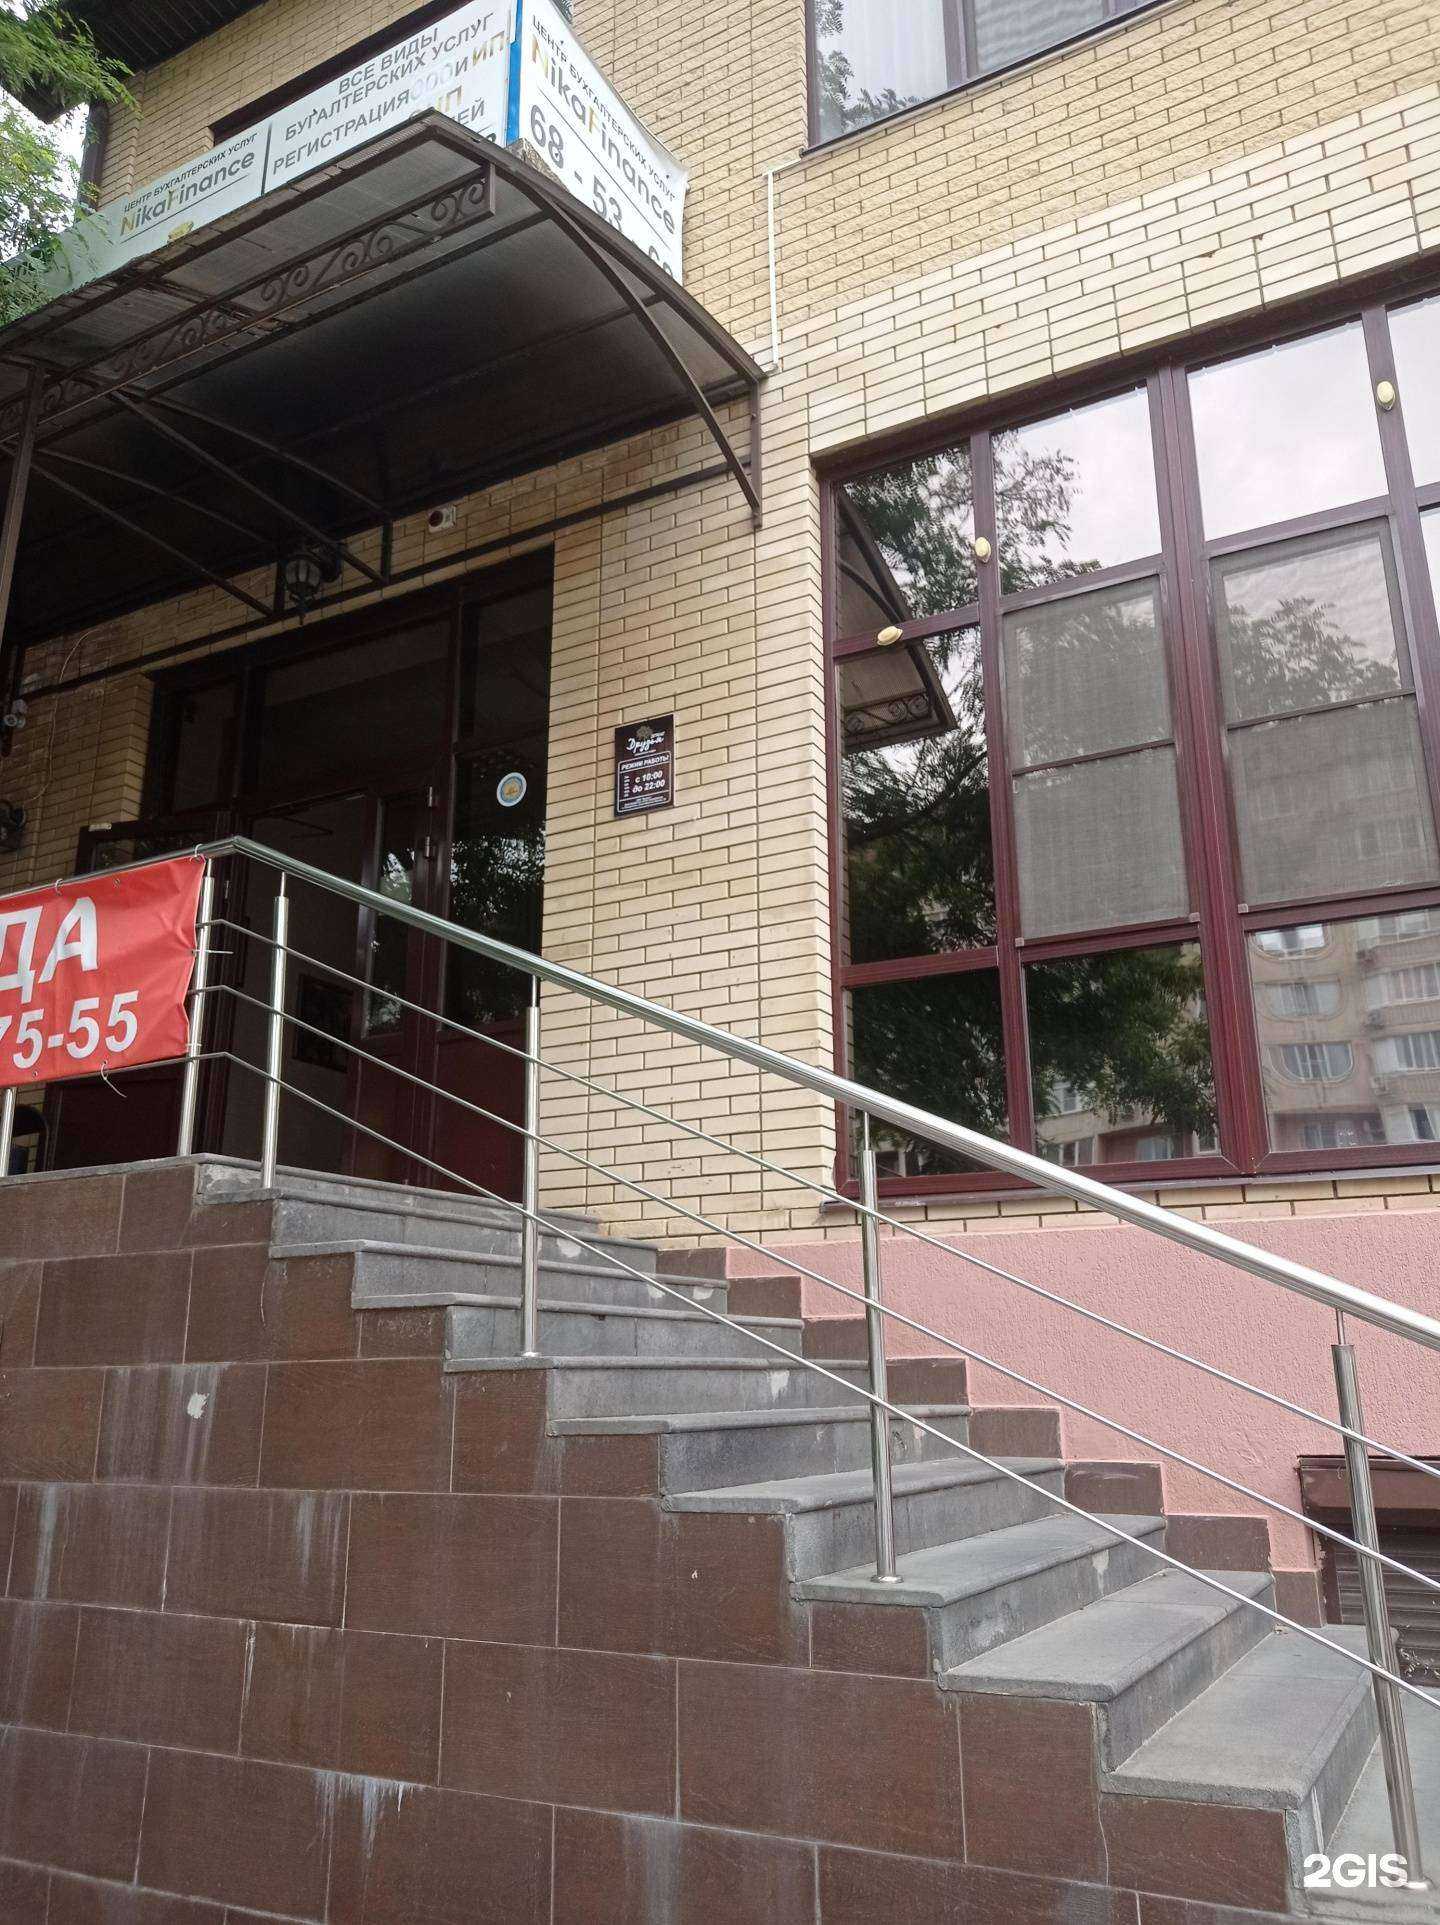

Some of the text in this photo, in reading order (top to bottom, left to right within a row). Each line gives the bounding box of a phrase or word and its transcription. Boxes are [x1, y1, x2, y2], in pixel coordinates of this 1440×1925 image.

[273, 90, 410, 175] РЕГИСТРАЦИЯ
[455, 56, 468, 77] И
[472, 31, 505, 66] ИП
[285, 13, 494, 141] БУГАЛТЕРСКИХ УСЛУГ
[339, 28, 438, 95] ВСЕ ВИДЫ
[532, 14, 676, 202] ЦЕНТР БУХГАЛТЕРСКИХ УСЛУГ
[124, 133, 257, 213] ЦЕНТР БУХГАЛТЕРСКИХ УСЛУГ
[531, 104, 564, 169] 68
[593, 175, 623, 232] 53
[532, 35, 675, 235] NikaFinance
[120, 152, 255, 236] NikaFinance
[621, 754, 670, 771] РЕЖИМ РАБОТЫ
[642, 770, 663, 782] 10:00
[644, 779, 665, 791] 22:00
[0, 896, 98, 1005] ДА
